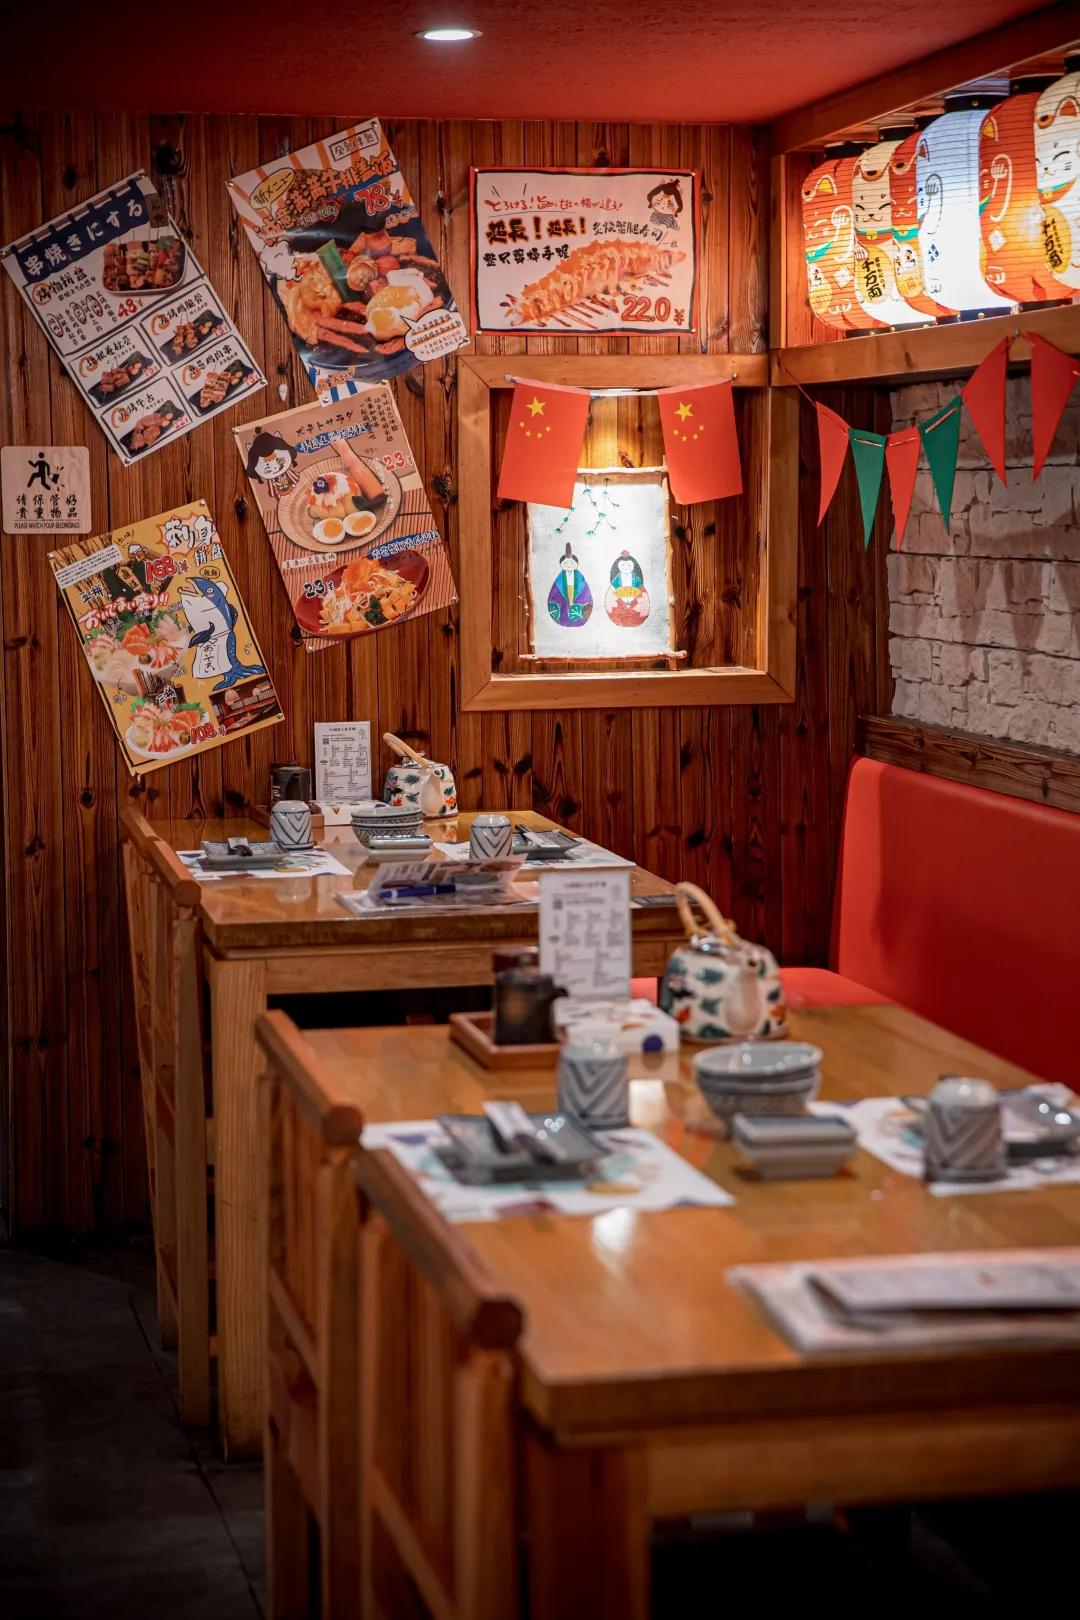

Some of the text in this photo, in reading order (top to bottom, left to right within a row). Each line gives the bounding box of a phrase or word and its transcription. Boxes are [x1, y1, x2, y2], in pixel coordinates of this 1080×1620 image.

[23, 198, 144, 277] 串焼きにする
[16, 493, 78, 506] 请保管好
[164, 515, 216, 549] 刺身
